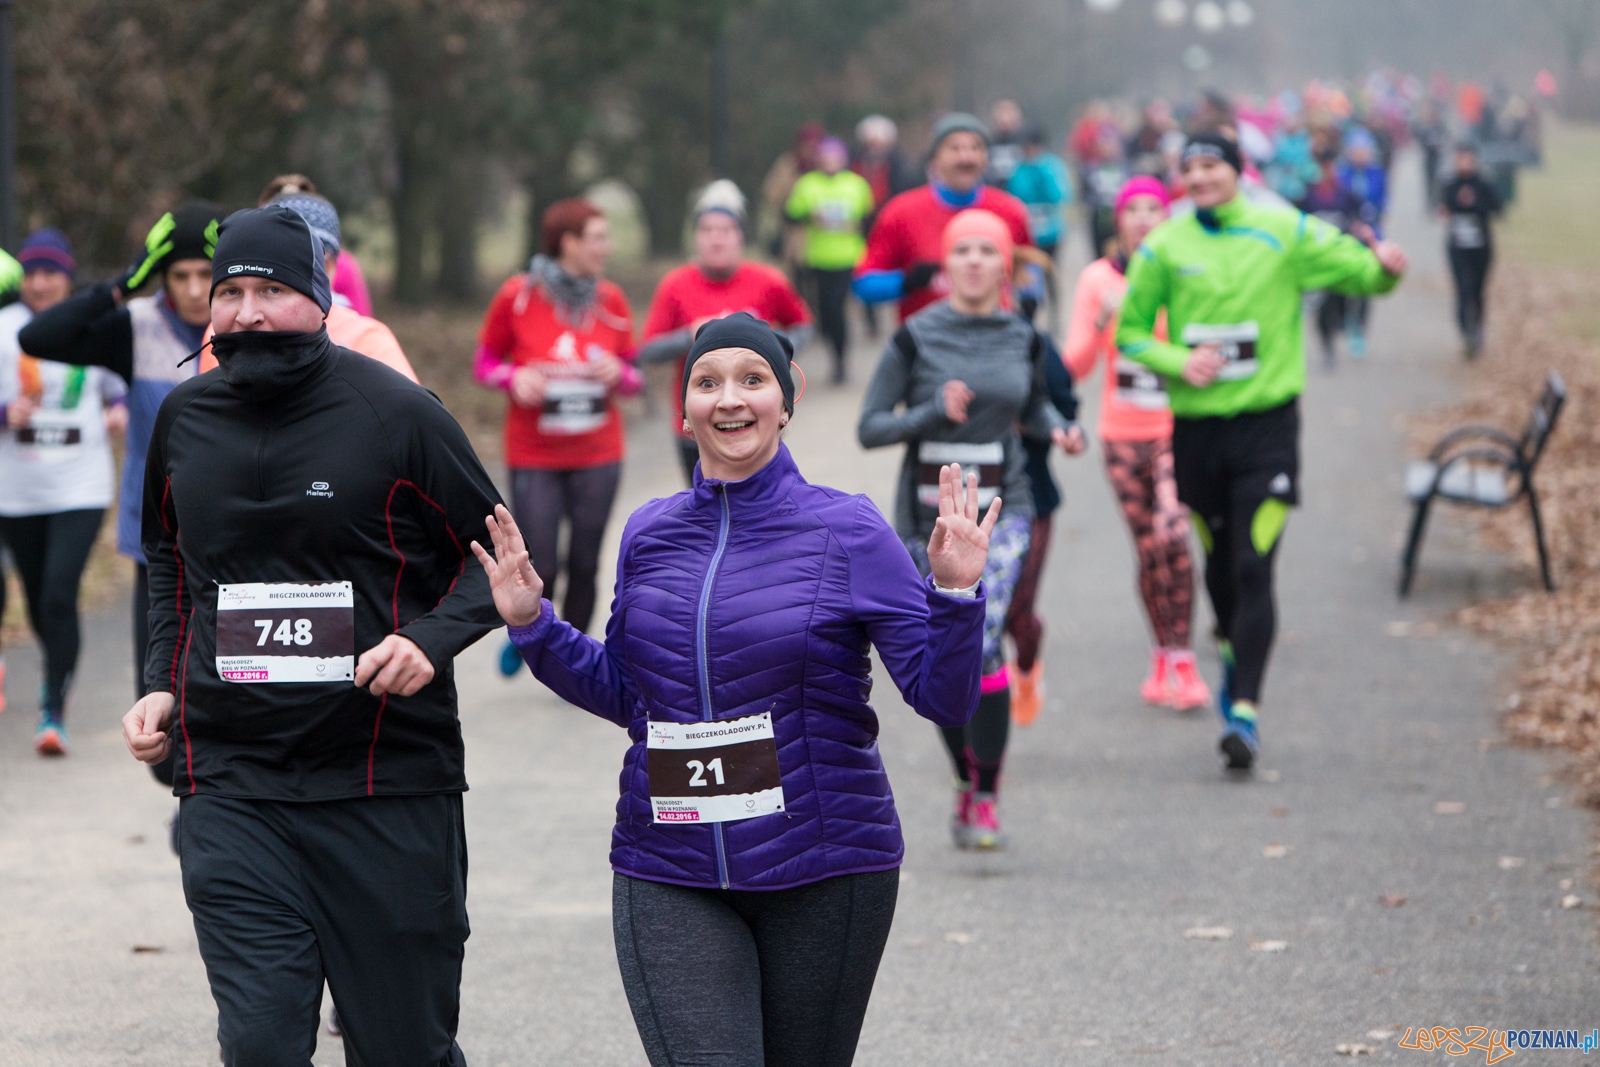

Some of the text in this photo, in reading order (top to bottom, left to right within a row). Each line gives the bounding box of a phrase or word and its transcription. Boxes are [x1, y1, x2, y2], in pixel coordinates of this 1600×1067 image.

[244, 265, 274, 274] Kalenji
[306, 490, 334, 498] Kalenji
[269, 591, 347, 599] BIEGCZEKOLADOWY.PL
[254, 618, 313, 646] 748
[685, 723, 767, 740] BIEGCZEKOLADOWY.PL
[685, 757, 725, 787] 21
